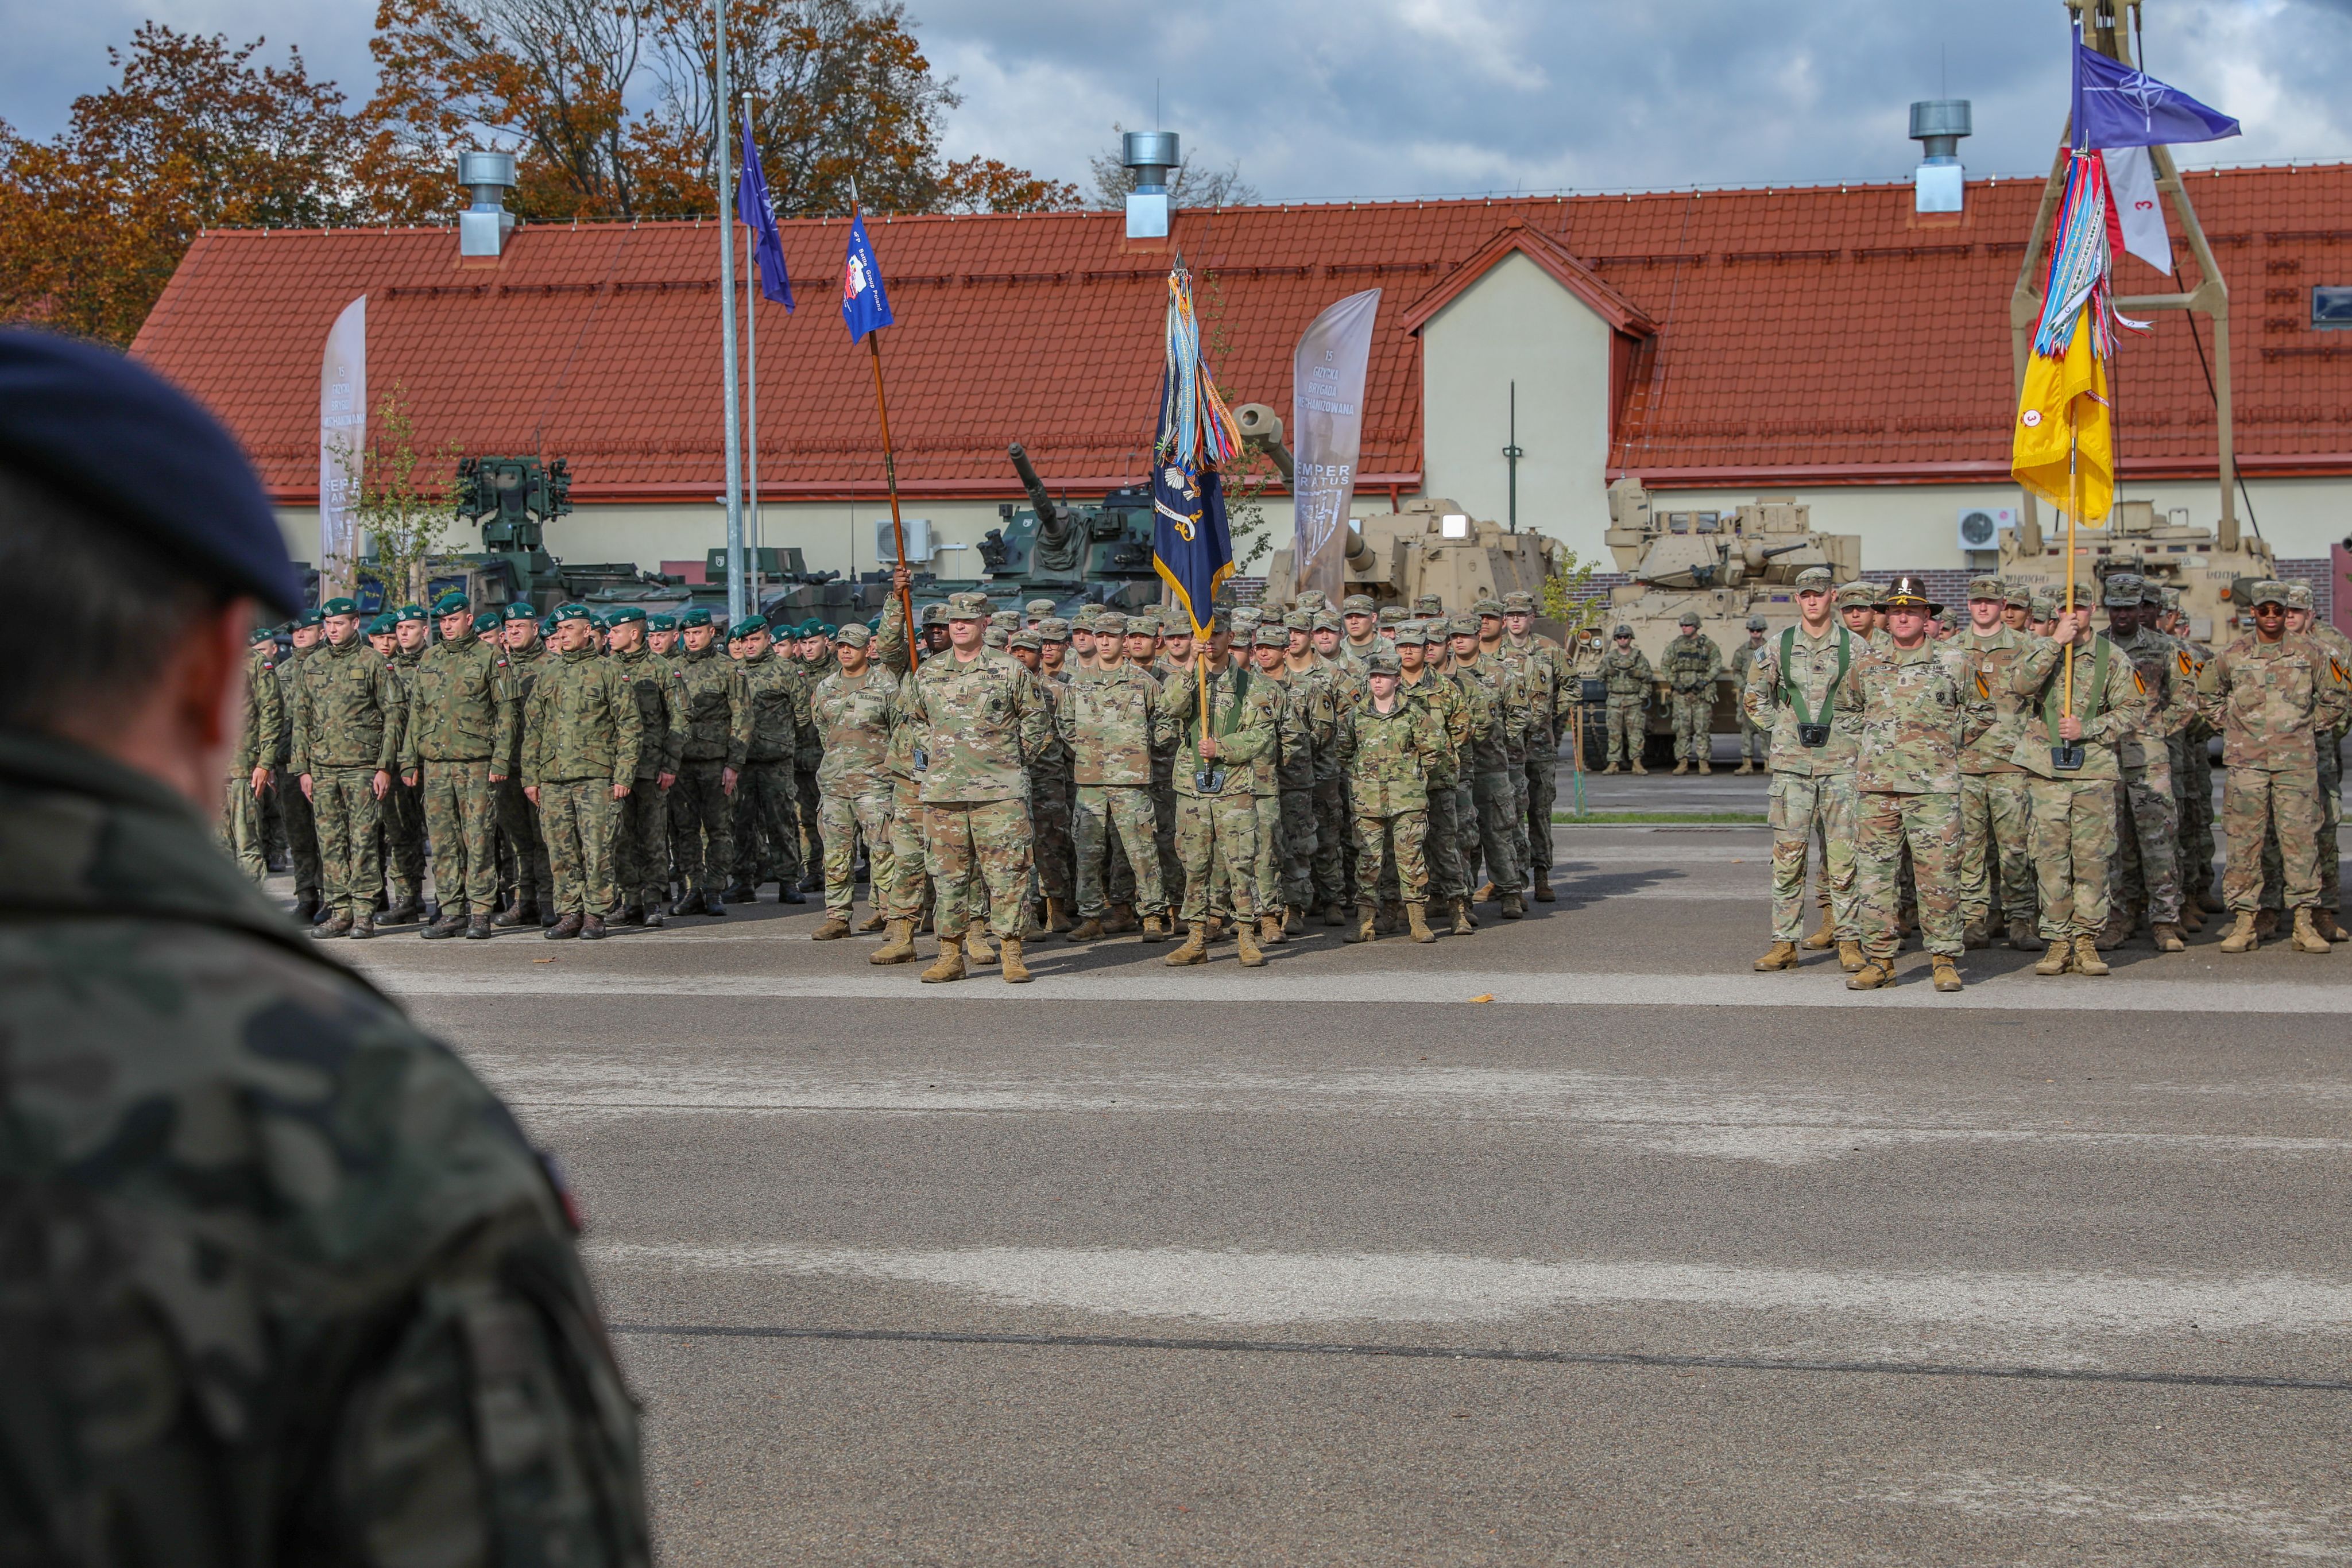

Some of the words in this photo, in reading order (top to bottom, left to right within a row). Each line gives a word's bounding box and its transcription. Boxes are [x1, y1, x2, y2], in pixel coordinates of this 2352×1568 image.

[858, 248, 868, 267] Battle
[866, 269, 875, 289] Group
[872, 290, 883, 312] Poland
[1325, 350, 1333, 361] 15
[338, 366, 345, 377] 15
[1307, 382, 1337, 397] BRYGADA
[1221, 699, 1232, 707] ARMY
